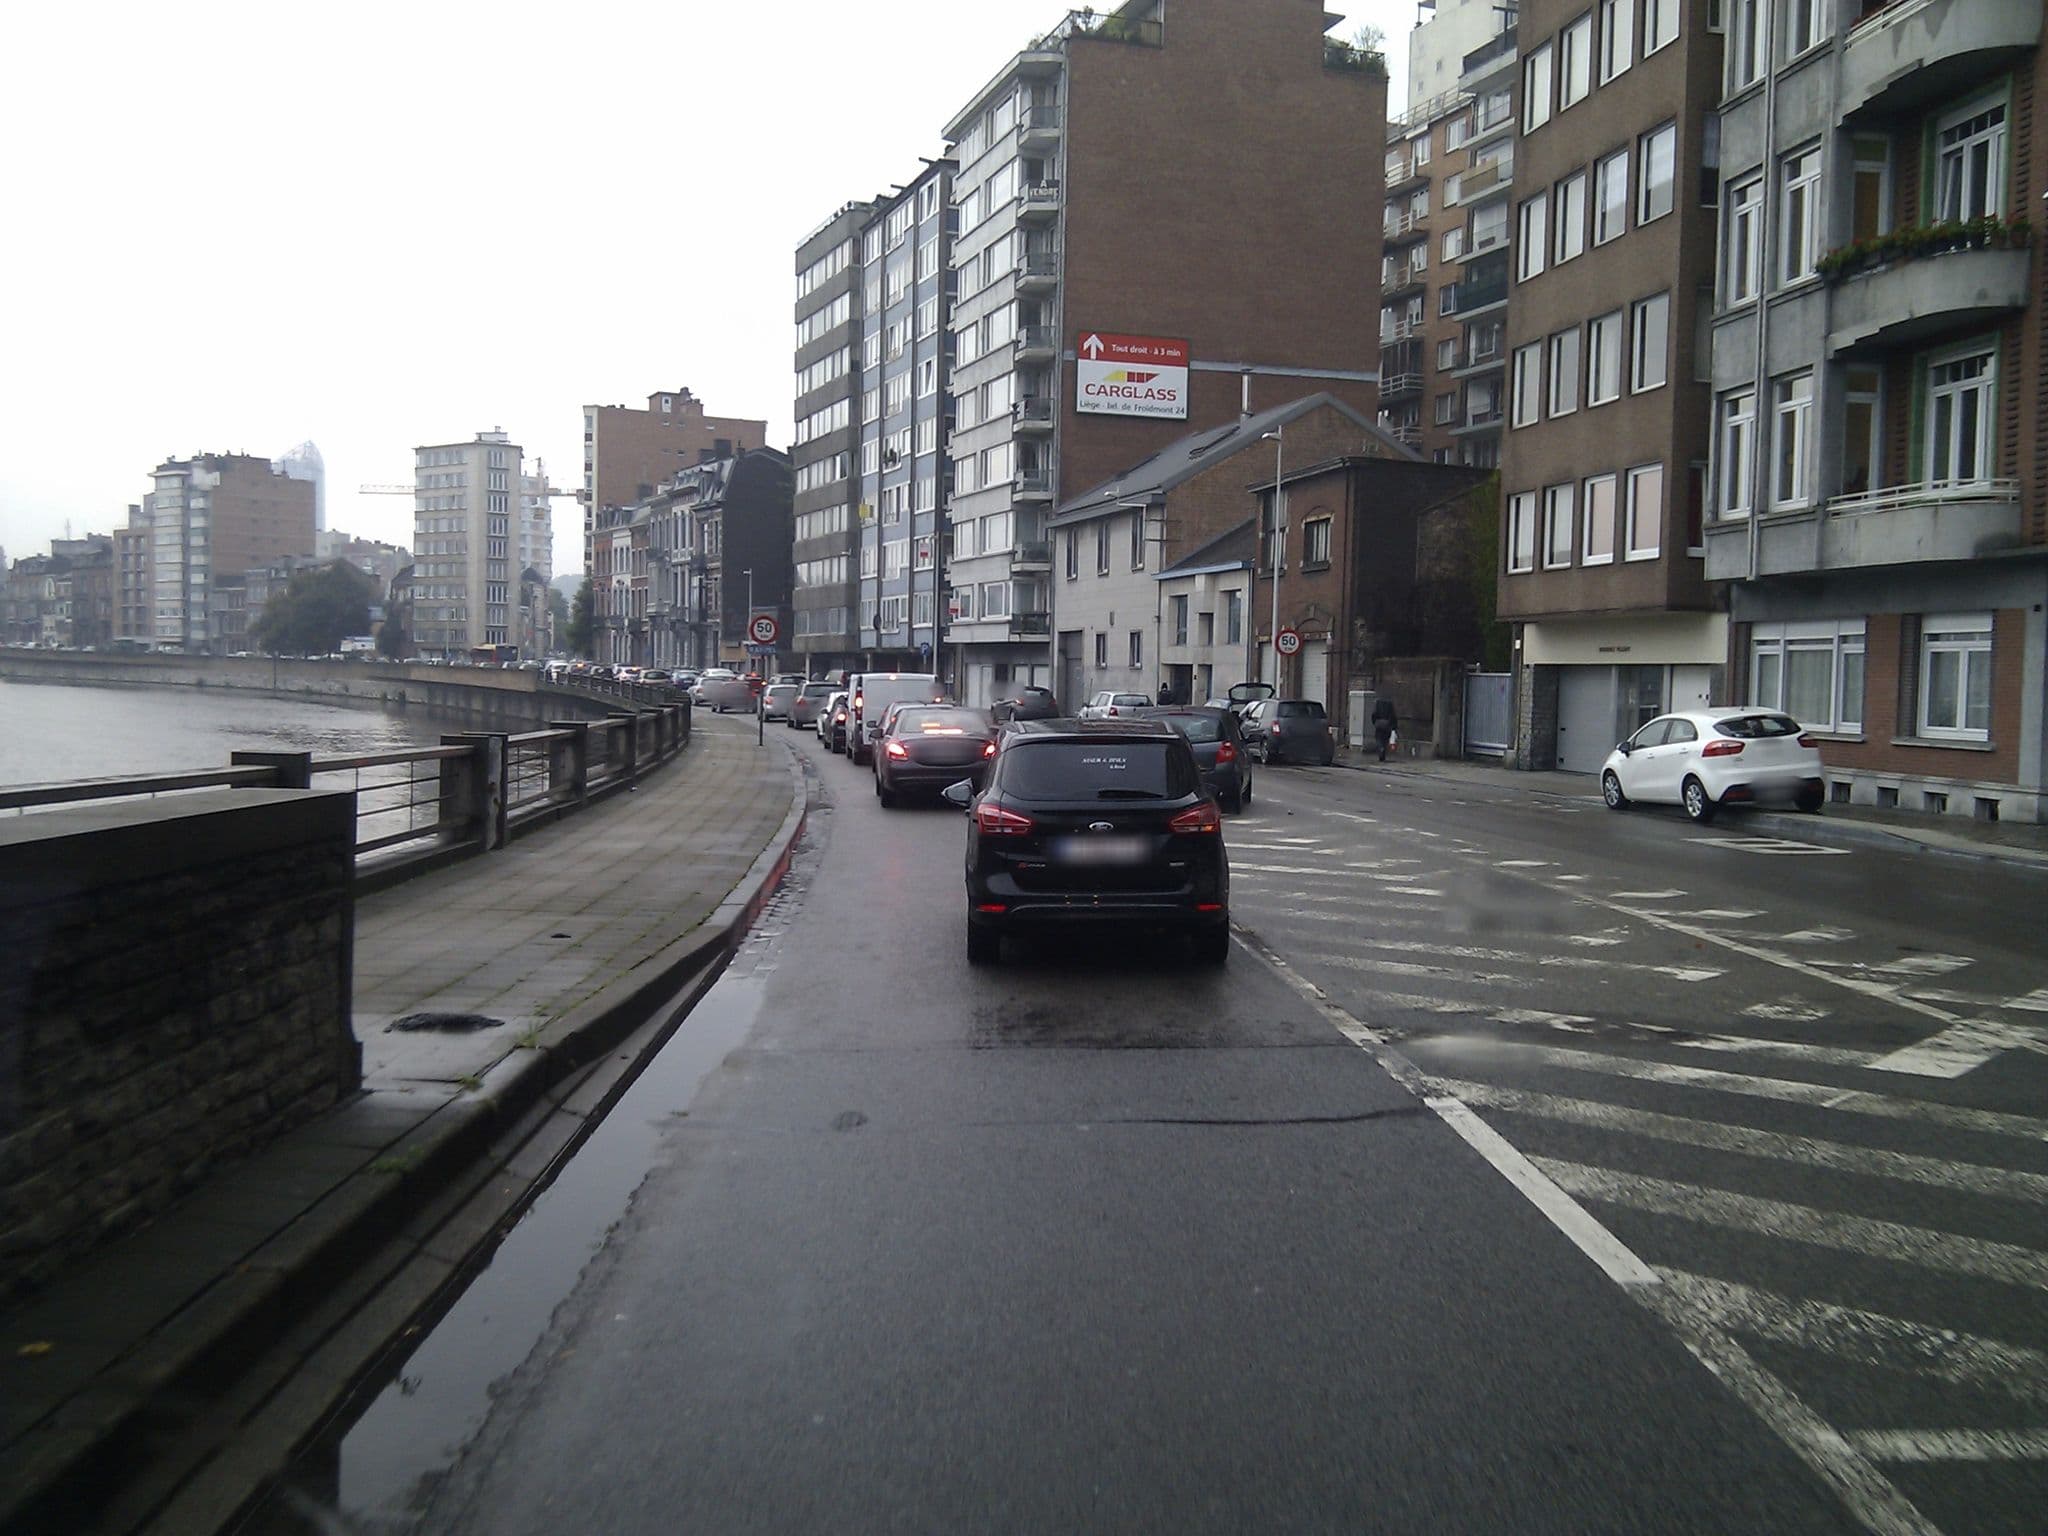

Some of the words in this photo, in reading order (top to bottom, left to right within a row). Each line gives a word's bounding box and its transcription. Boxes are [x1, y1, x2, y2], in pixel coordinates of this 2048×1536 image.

[1112, 343, 1128, 352] Tout
[1130, 345, 1148, 354] droit
[1160, 347, 1166, 356] 3
[1166, 348, 1181, 357] min
[1085, 383, 1177, 401] CARGLASS
[1080, 400, 1100, 410] Liège
[1121, 403, 1131, 411] de
[1134, 404, 1173, 414] Froidmont
[1175, 406, 1185, 415] 24
[757, 622, 772, 633] 50
[1281, 635, 1296, 646] 50
